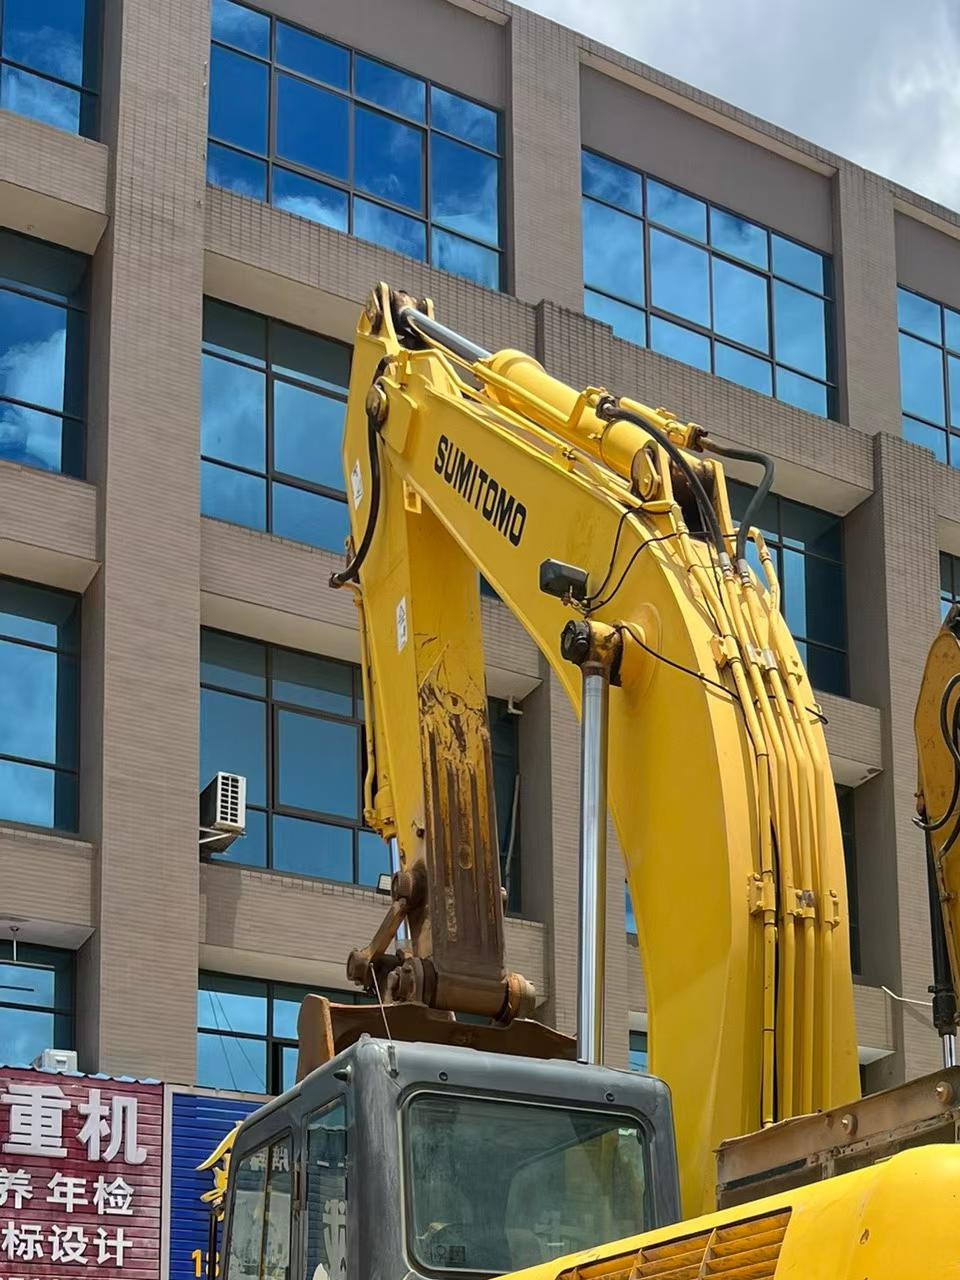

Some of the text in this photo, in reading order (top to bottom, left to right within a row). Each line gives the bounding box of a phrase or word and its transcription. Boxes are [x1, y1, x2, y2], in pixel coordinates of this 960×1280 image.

[433, 434, 527, 547] SUMITOMO
[0, 1084, 147, 1165] 重机
[1, 1221, 134, 1267] 标设计
